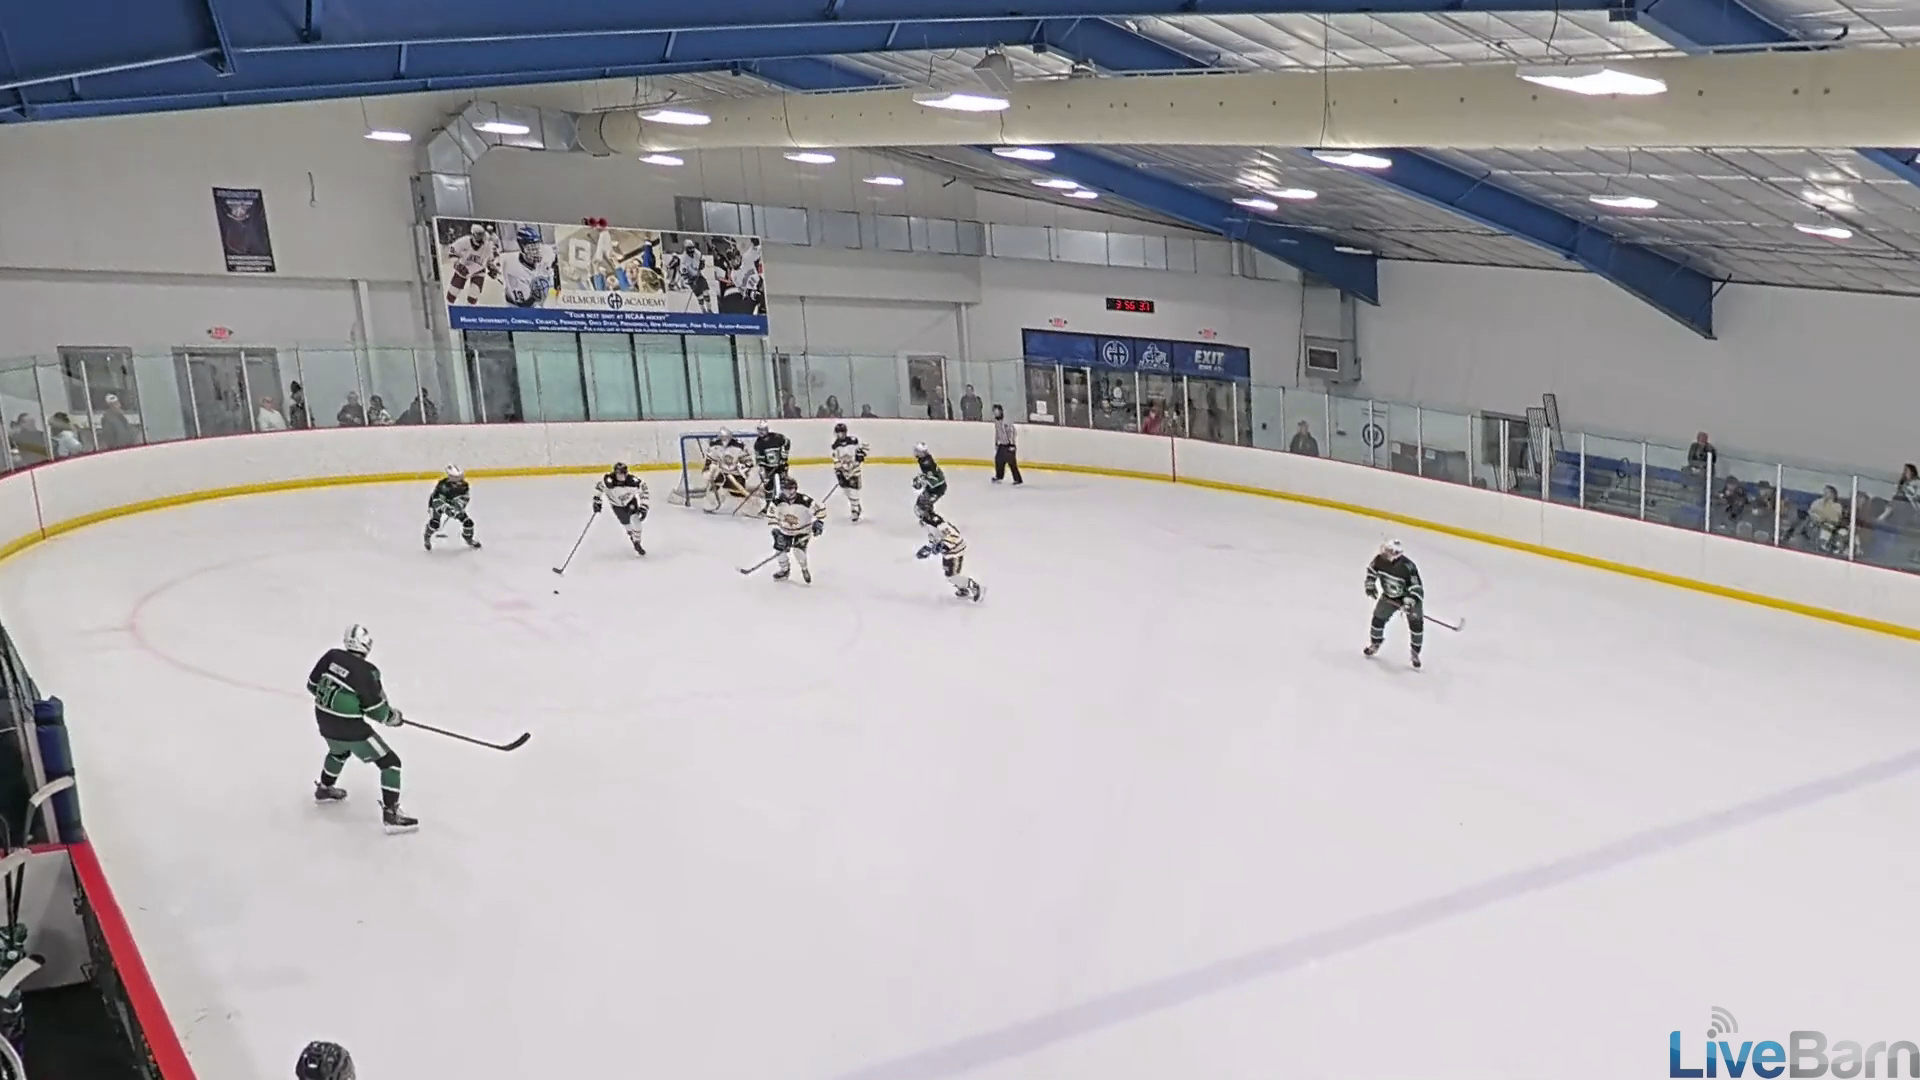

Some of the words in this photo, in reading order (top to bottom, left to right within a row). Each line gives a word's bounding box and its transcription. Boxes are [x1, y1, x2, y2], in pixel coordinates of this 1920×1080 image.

[562, 295, 606, 305] GILMOUR
[624, 297, 666, 307] ACADEMY
[1194, 349, 1225, 367] EXIT
